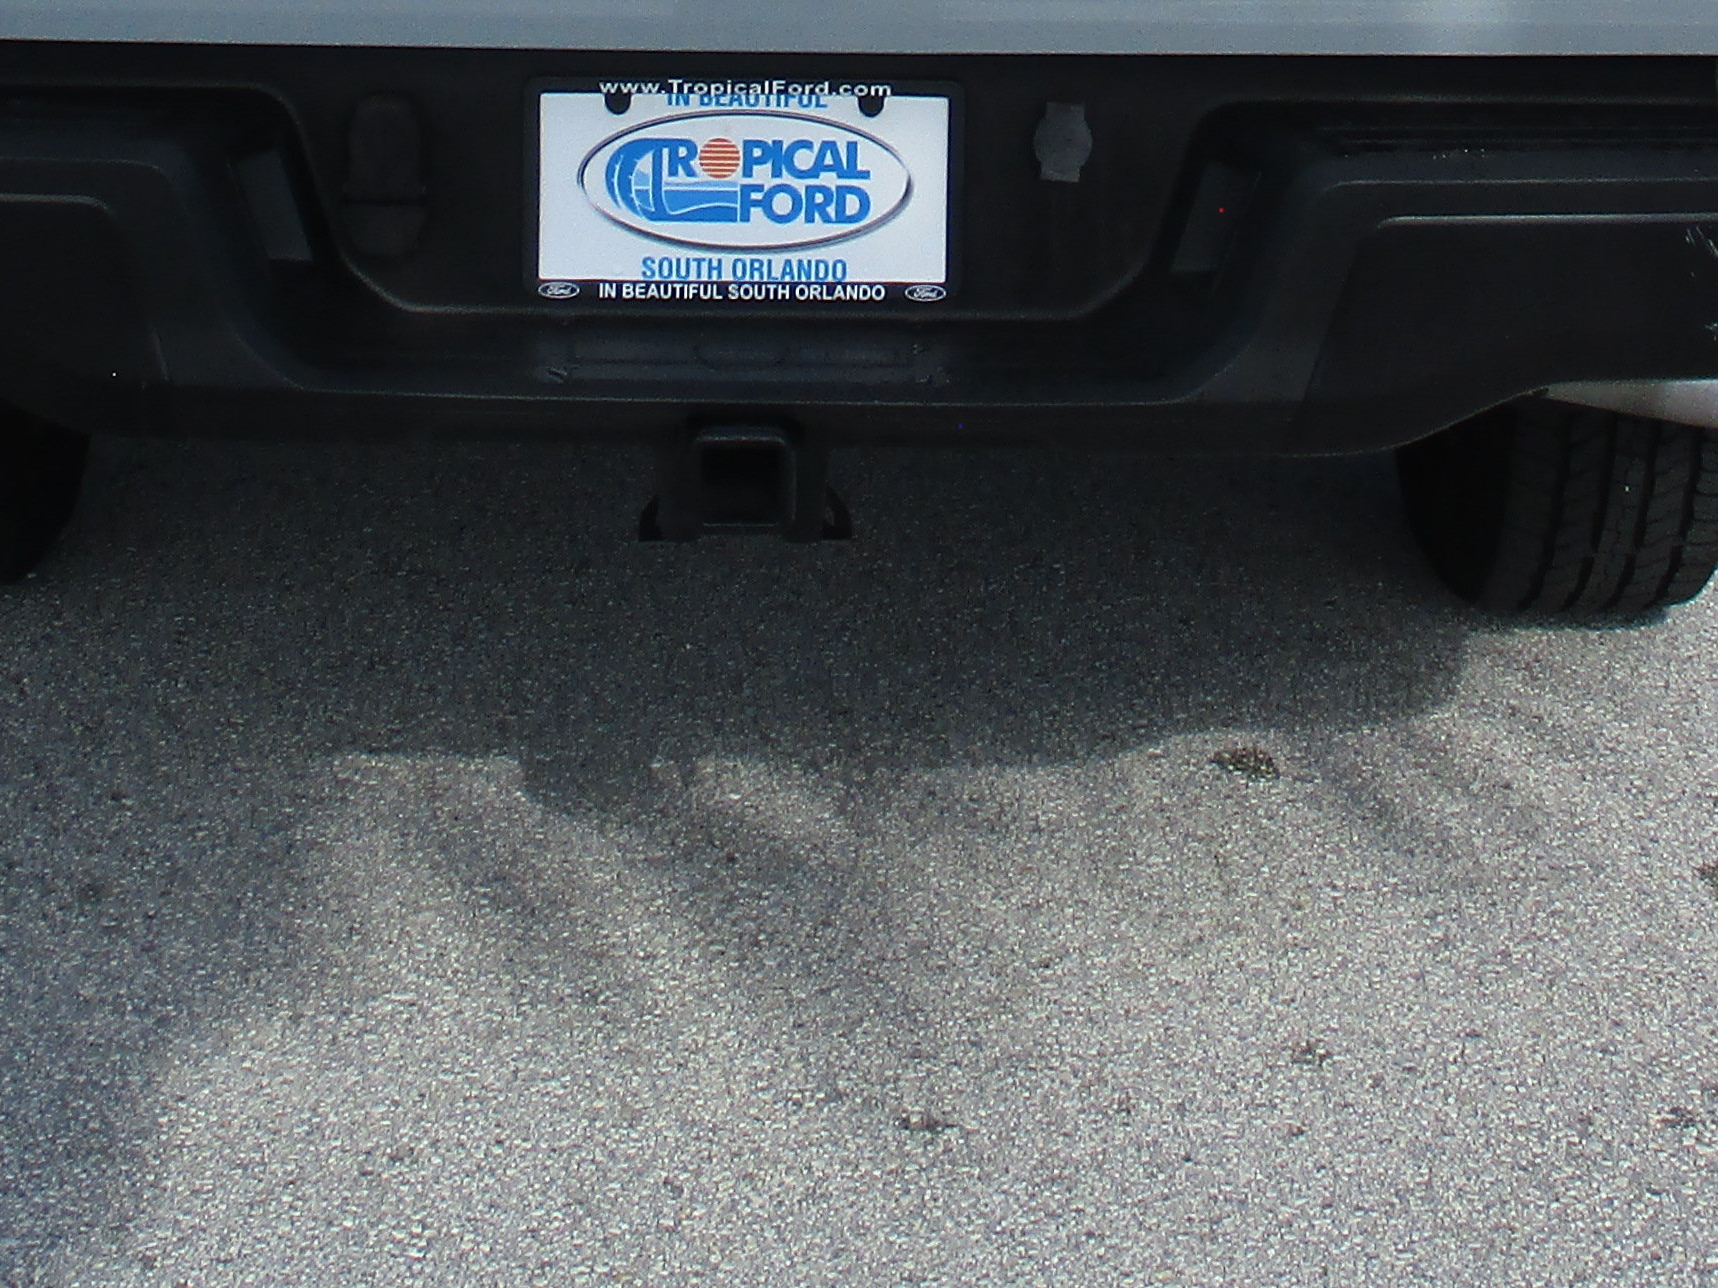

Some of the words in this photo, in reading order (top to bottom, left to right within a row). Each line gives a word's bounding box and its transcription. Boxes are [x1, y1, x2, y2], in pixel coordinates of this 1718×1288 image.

[599, 79, 892, 98] www.TropicalFord.com
[667, 93, 689, 107] IN
[699, 93, 828, 109] BEAUTIFUL
[605, 137, 871, 181] TROPICAL
[739, 184, 871, 224] FORD
[641, 256, 723, 280] SOUTH
[732, 258, 847, 282] ORLANDO
[598, 283, 617, 299] IN
[622, 283, 723, 299] BEAUTIFUL
[728, 284, 790, 300] SOUTH
[795, 284, 885, 301] ORLANDO
